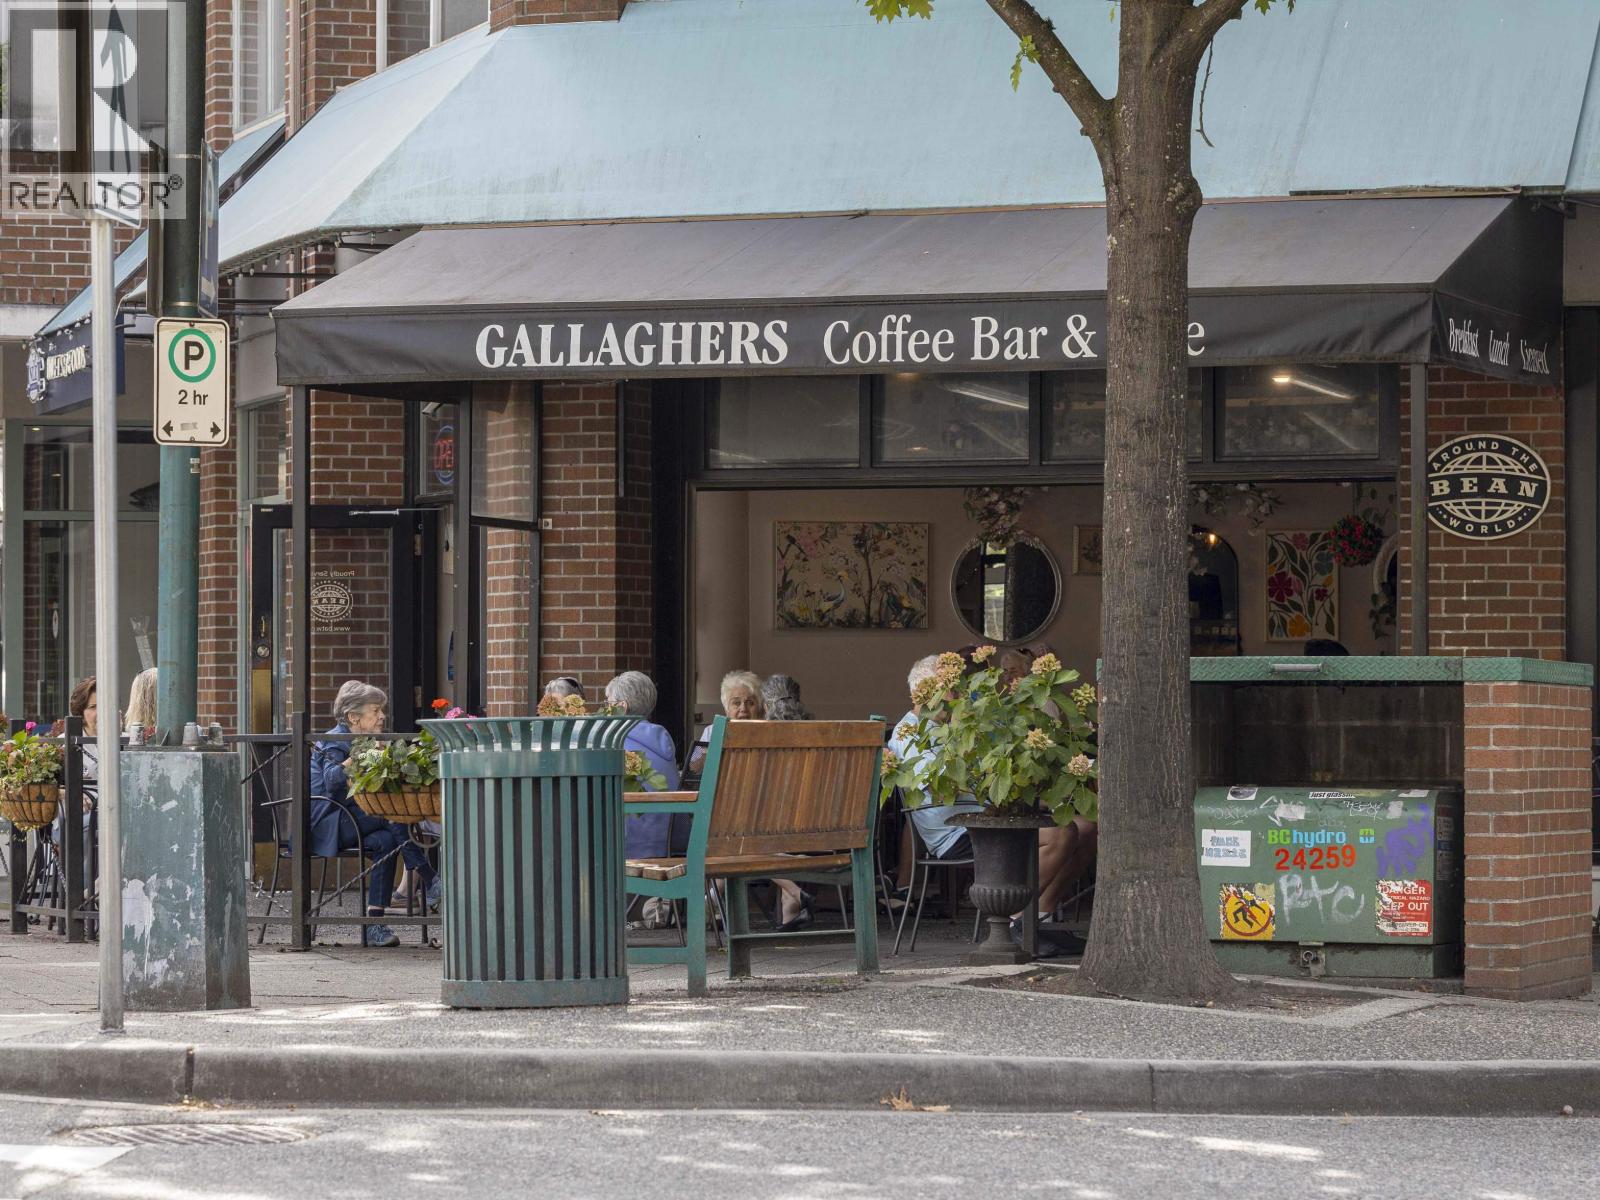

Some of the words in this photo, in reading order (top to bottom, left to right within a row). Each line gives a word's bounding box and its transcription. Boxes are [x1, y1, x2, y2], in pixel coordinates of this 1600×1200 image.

[475, 319, 789, 368] GALLAGHERS
[823, 314, 955, 365] Coffee
[971, 315, 1048, 361] Bar
[1061, 314, 1098, 359] &
[184, 340, 204, 371] P
[177, 389, 188, 405] 2
[193, 389, 209, 405] hr
[1432, 440, 1500, 472] AROUND
[1511, 446, 1538, 473] THE
[1429, 477, 1539, 498] BEAN
[1449, 515, 1516, 534] WORLD
[1274, 844, 1357, 871] 24259
[1407, 901, 1429, 911] OUT
